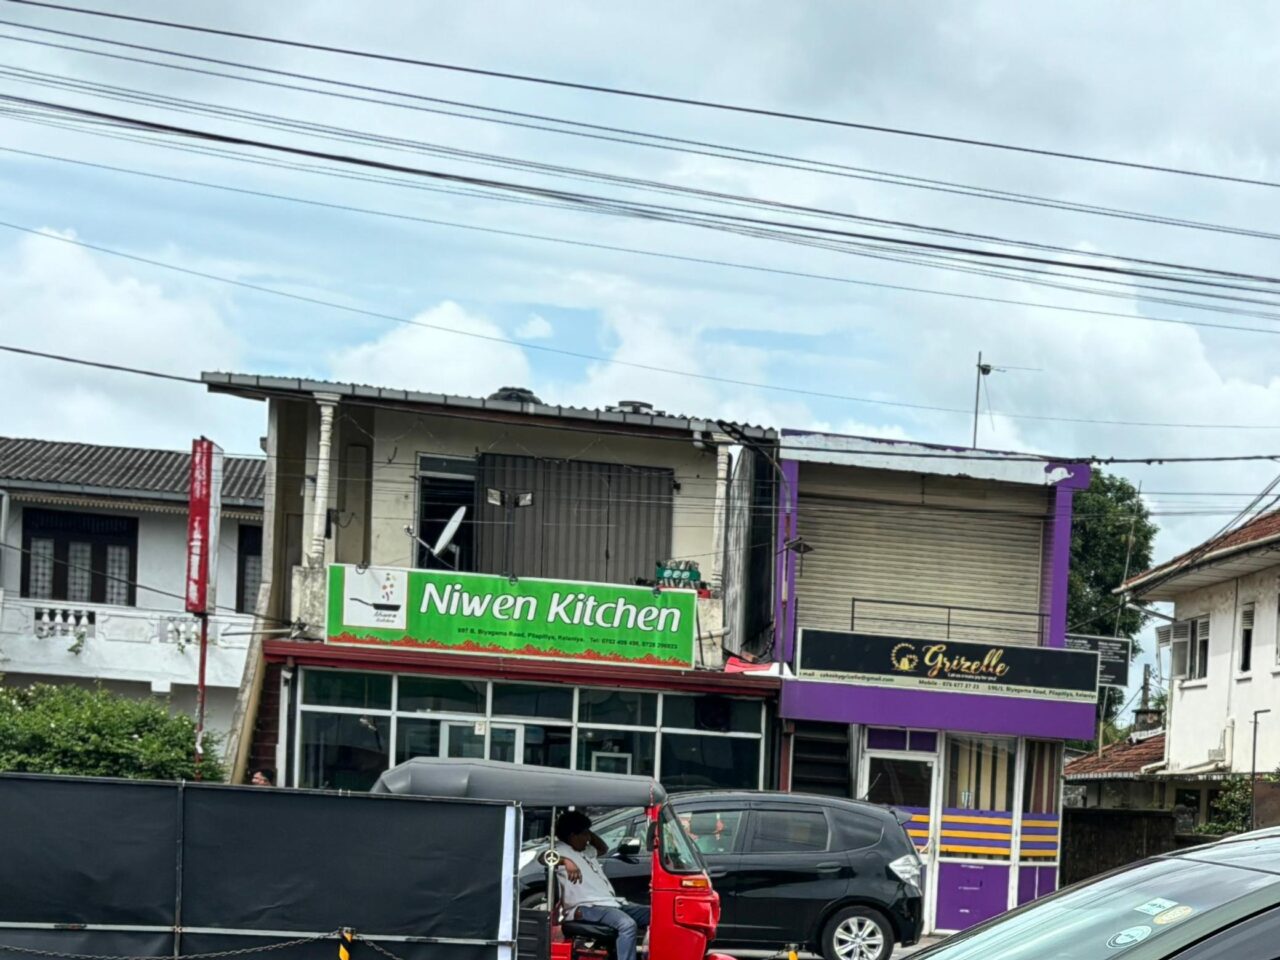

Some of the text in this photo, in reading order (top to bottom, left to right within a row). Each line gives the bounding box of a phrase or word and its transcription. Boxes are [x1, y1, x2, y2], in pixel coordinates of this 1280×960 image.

[419, 582, 682, 633] Niwen Kitchen
[922, 644, 1010, 678] Grizelle
